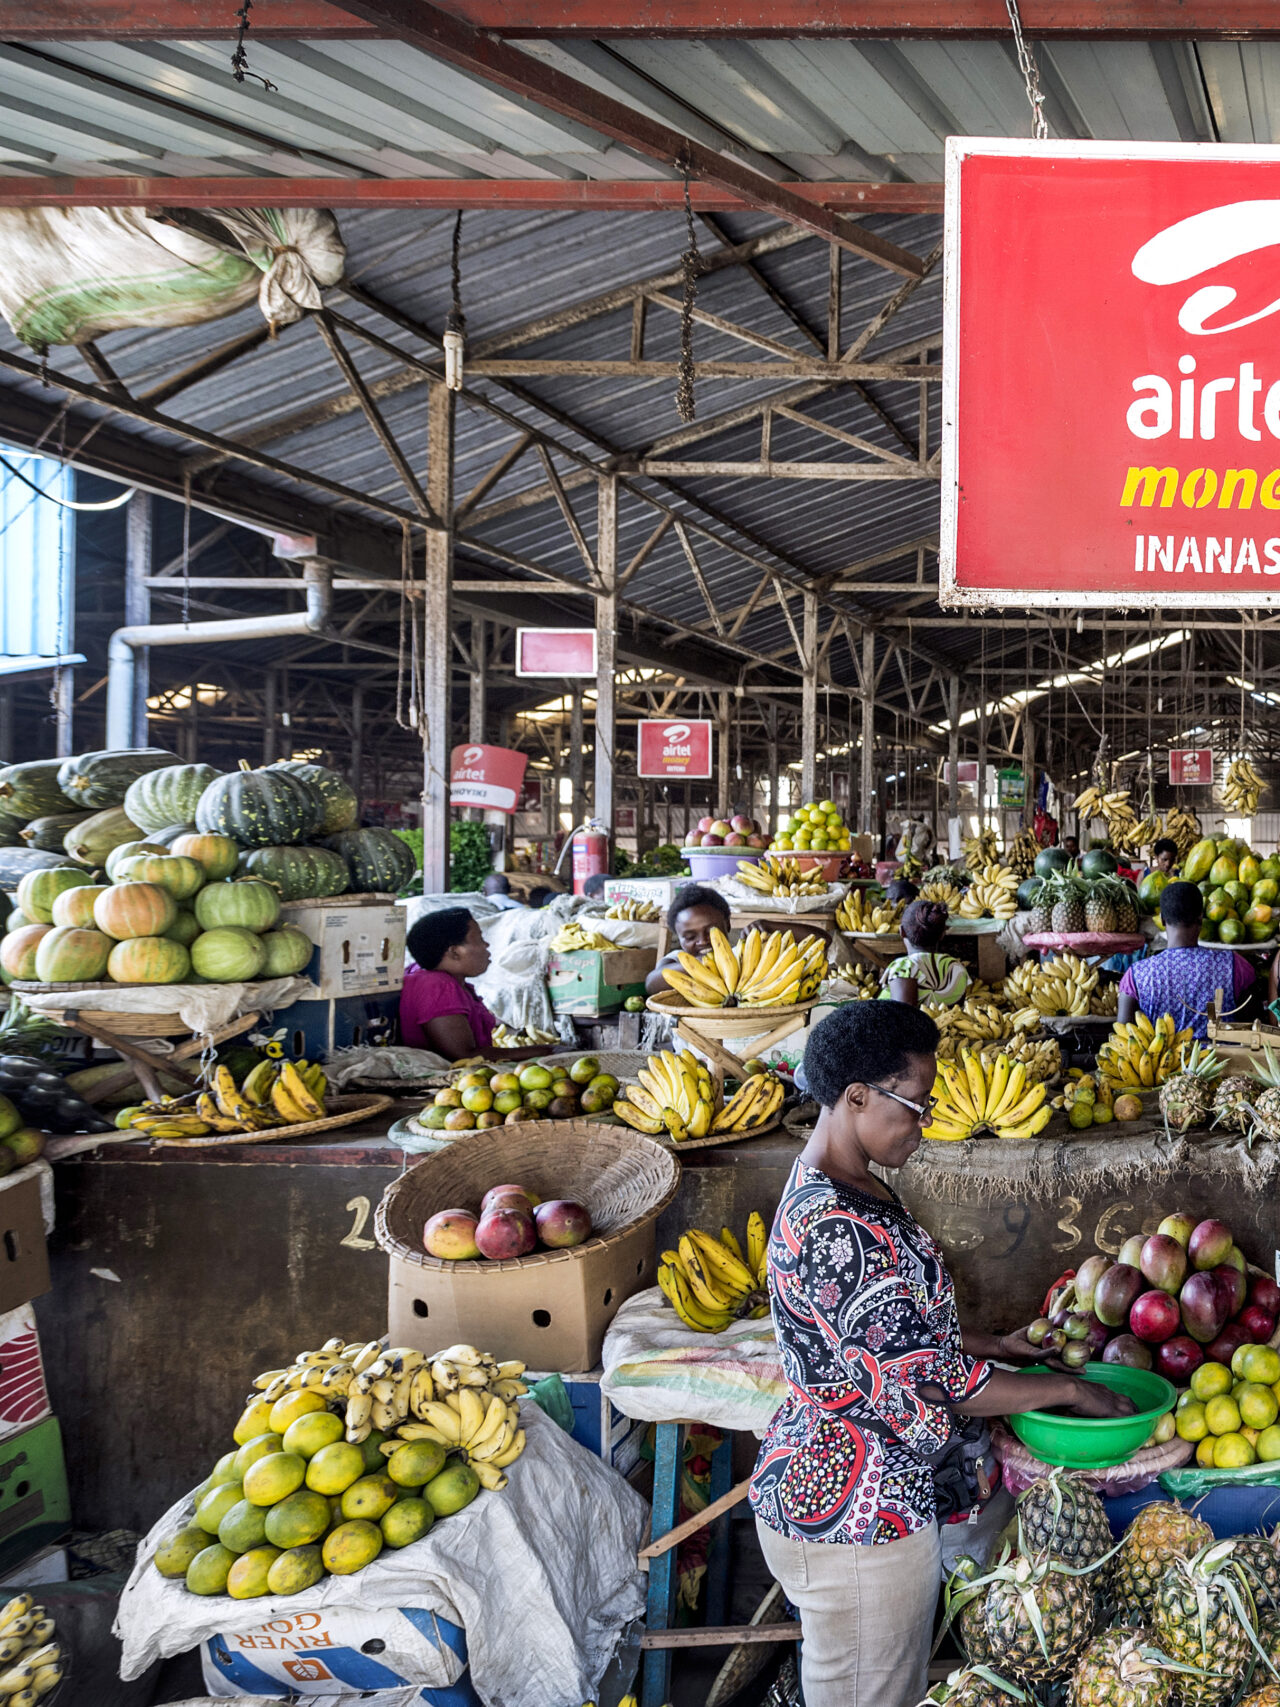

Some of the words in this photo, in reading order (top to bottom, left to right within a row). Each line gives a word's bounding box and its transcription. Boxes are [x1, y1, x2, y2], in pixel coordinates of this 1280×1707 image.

[663, 745, 691, 756] airtel
[453, 769, 485, 780] airtel
[41, 1036, 83, 1053] OIT
[340, 1195, 376, 1251] 2
[233, 1631, 335, 1650] RIVER
